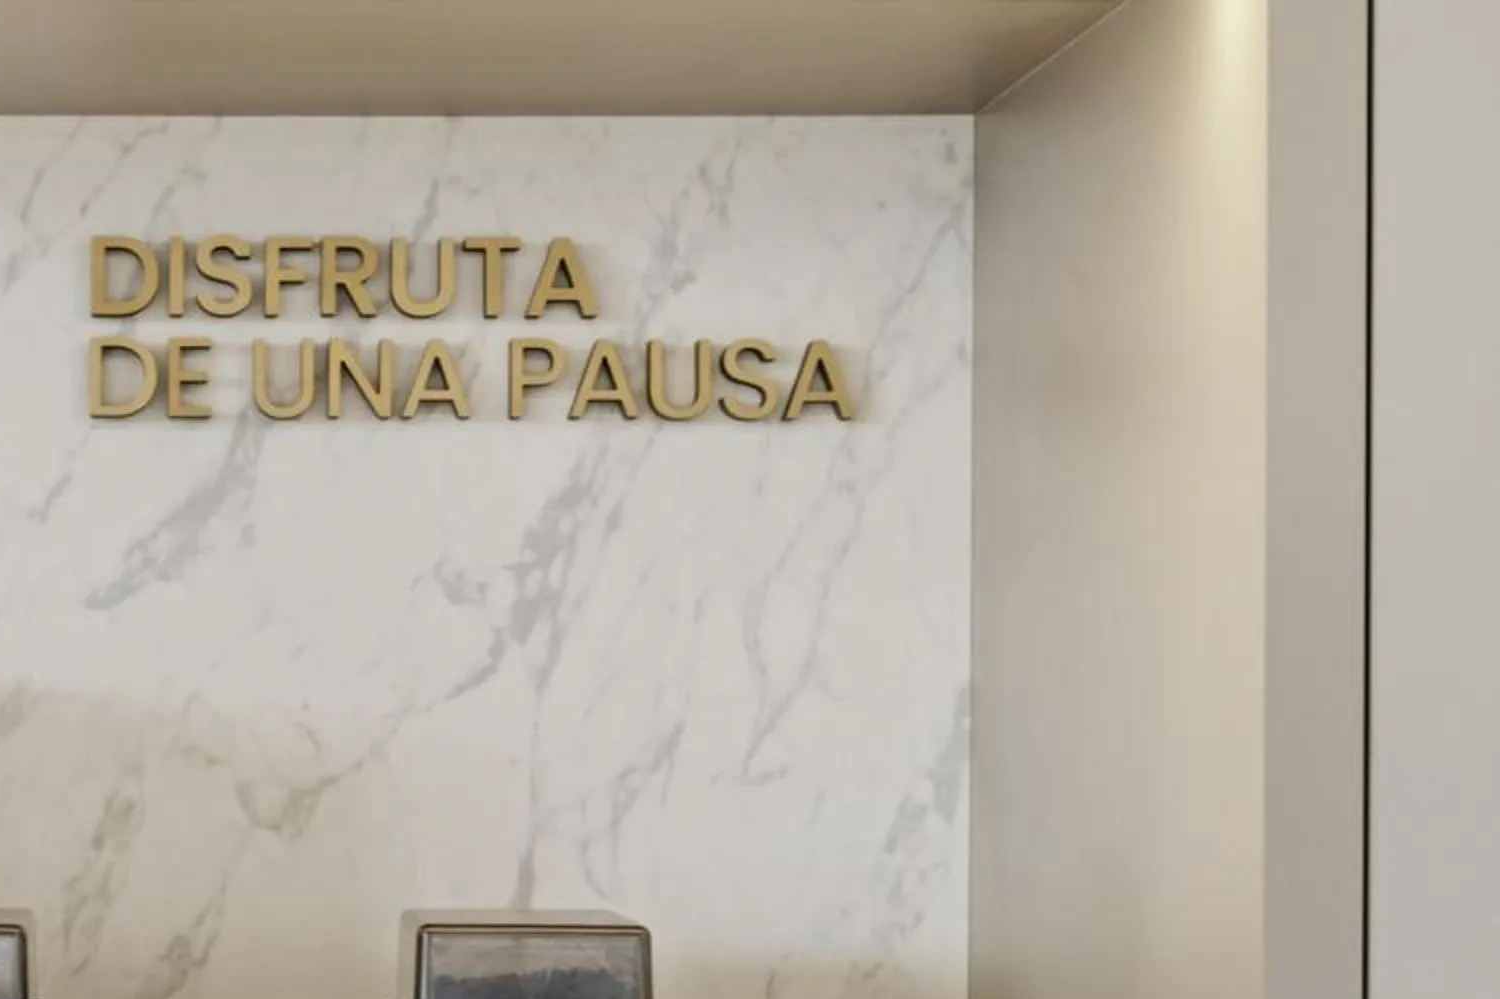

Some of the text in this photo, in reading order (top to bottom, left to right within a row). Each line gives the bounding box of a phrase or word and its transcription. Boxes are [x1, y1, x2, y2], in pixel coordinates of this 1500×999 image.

[90, 236, 598, 319] DISFRUTA
[90, 337, 855, 420] DE UNA PAUSA
